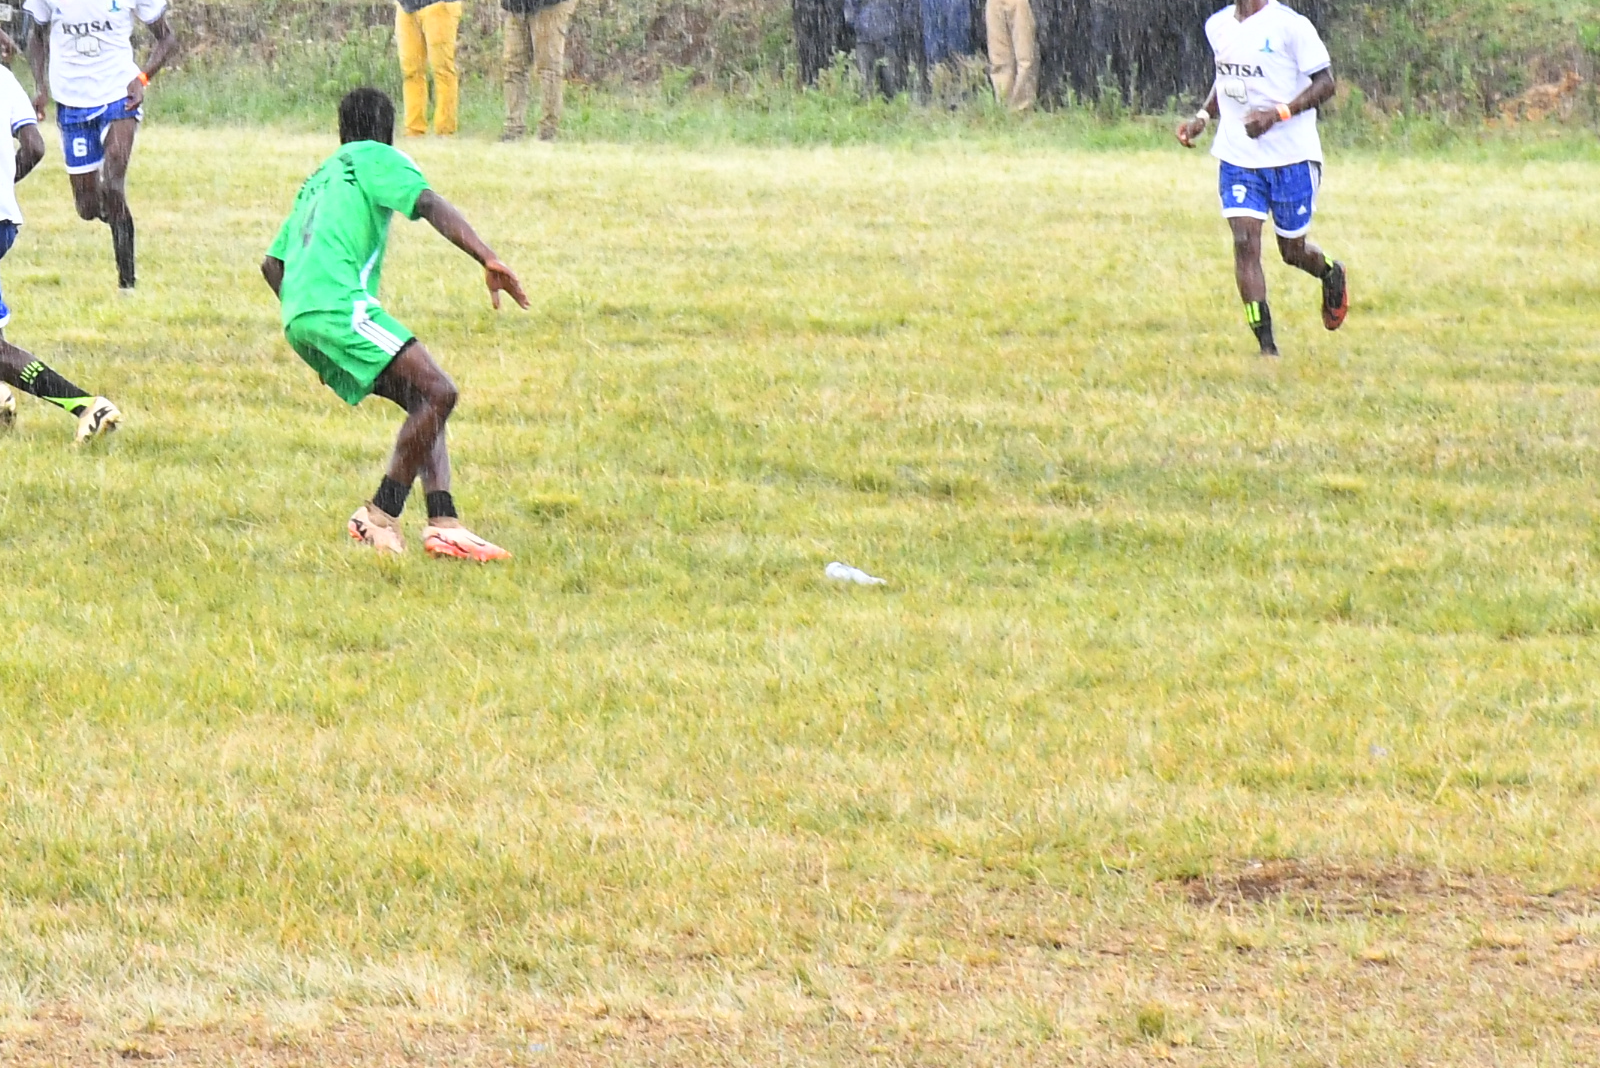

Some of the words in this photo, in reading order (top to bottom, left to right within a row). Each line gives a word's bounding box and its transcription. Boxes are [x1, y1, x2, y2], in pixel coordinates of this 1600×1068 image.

[61, 20, 114, 35] KYISA
[1216, 62, 1265, 78] KYISA
[72, 137, 88, 157] 6
